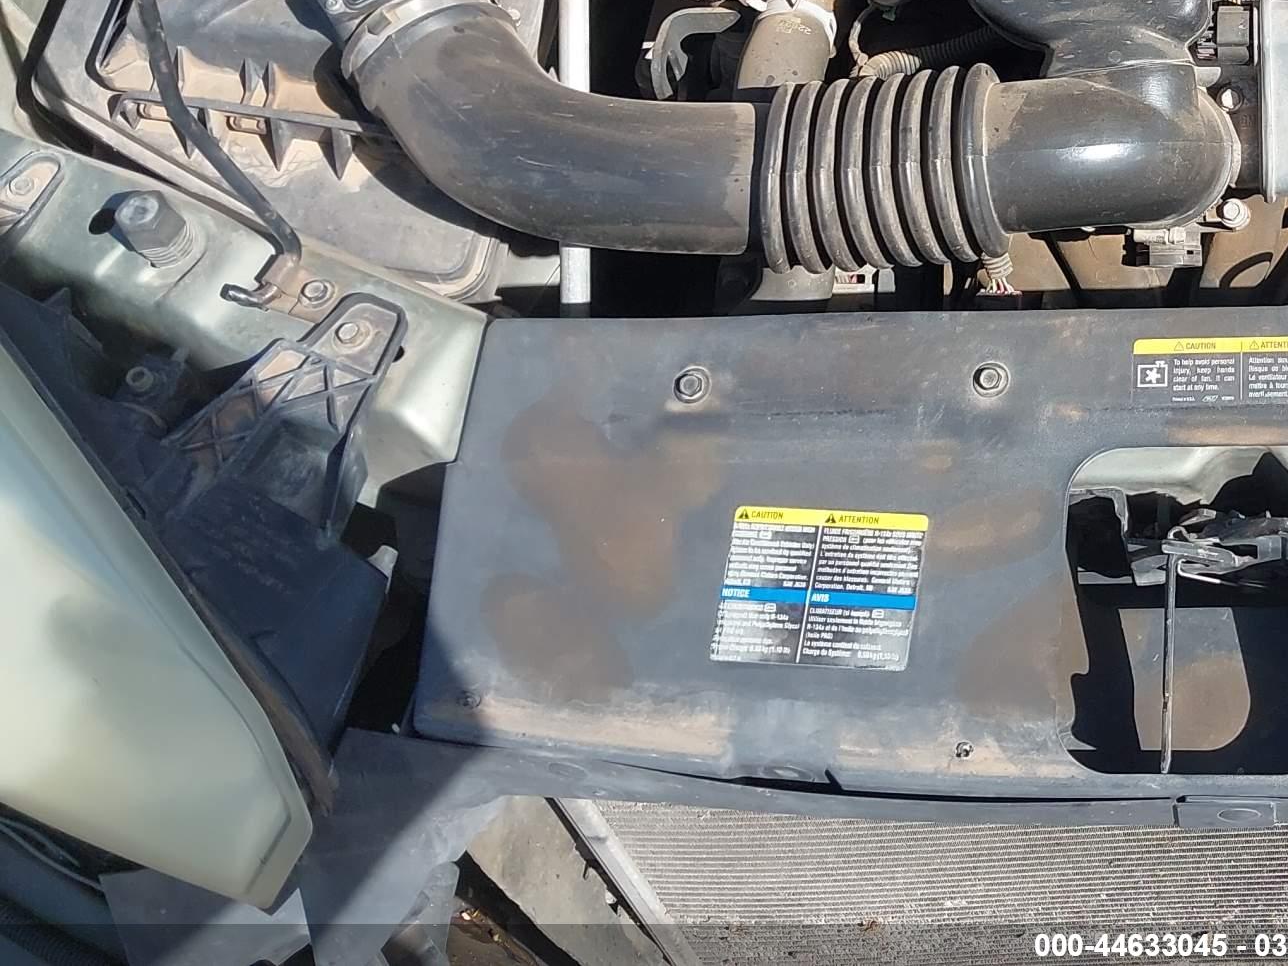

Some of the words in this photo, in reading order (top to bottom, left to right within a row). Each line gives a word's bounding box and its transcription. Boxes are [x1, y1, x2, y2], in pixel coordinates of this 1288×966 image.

[1185, 342, 1217, 350] CAUTION
[1211, 358, 1235, 366] personal
[1248, 356, 1275, 364] Attention
[1197, 367, 1211, 375] keep
[1217, 366, 1235, 374] hands
[1193, 385, 1205, 393] any
[751, 511, 784, 520] CAUTION
[838, 516, 880, 524] ATTENTION
[721, 588, 751, 598] NOTICE
[811, 593, 830, 603] AVIS
